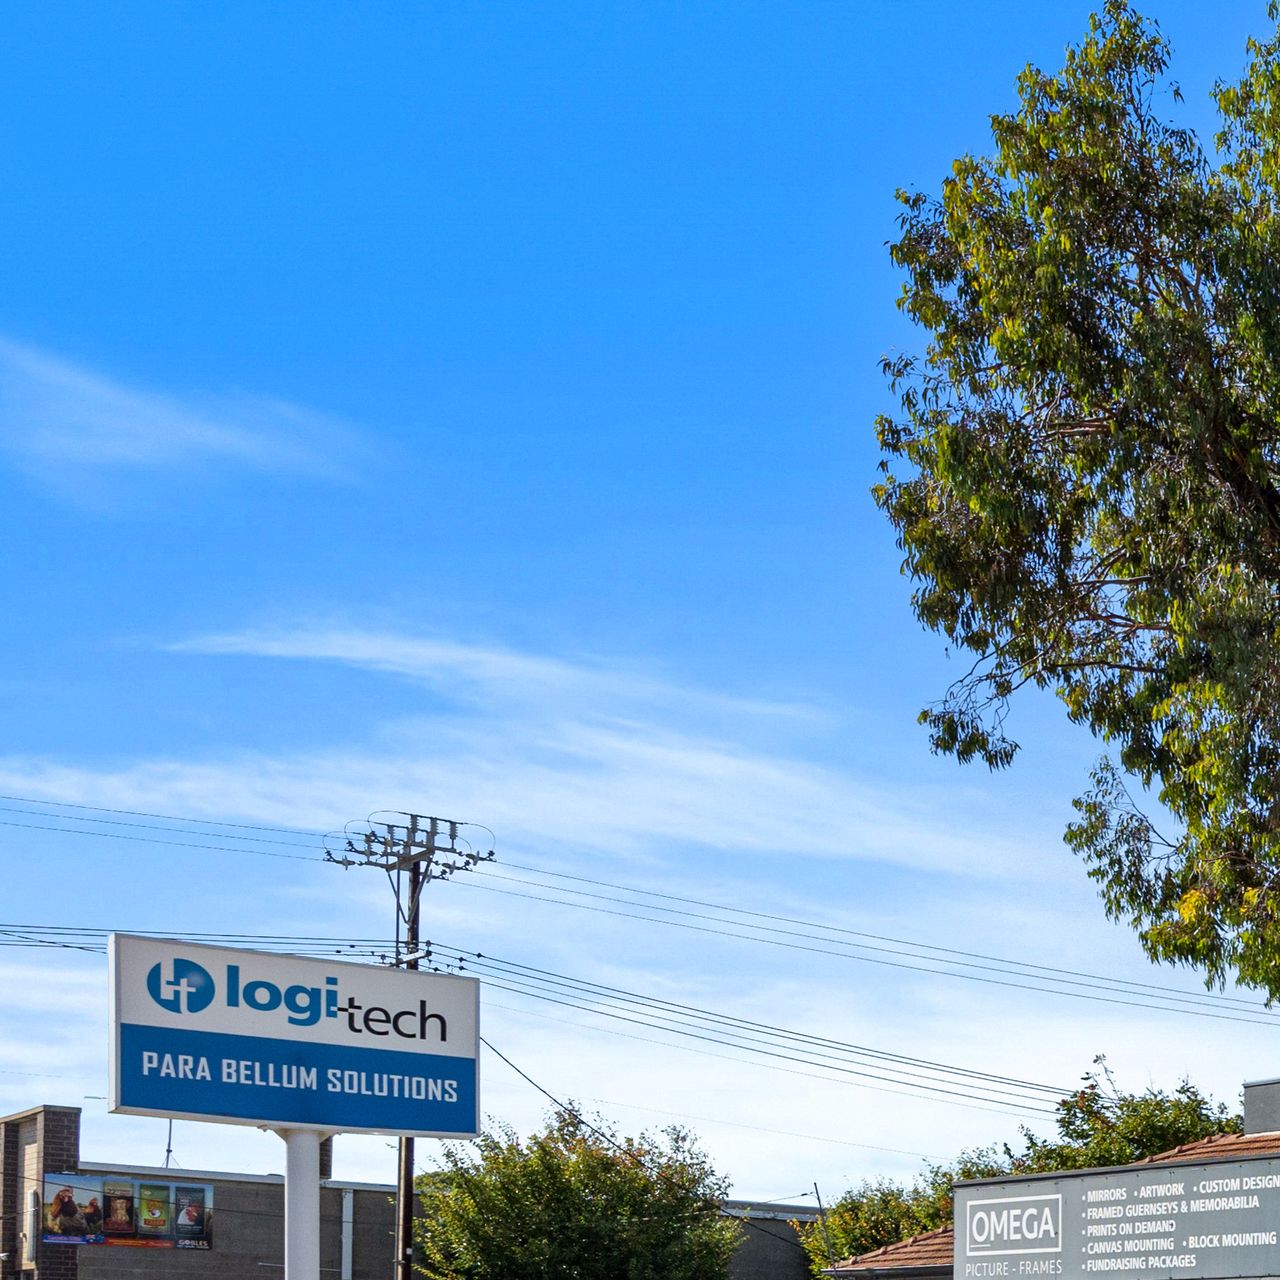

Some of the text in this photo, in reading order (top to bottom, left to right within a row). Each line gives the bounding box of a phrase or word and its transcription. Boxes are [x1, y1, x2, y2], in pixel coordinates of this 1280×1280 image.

[142, 1050, 458, 1103] PARA BELLUM SOLUTIONS
[1087, 1188, 1127, 1202] MIRRORS
[1139, 1182, 1185, 1198] ARTWORK
[1199, 1178, 1240, 1193] CUSTOM
[1087, 1195, 1260, 1219] FRAMED GUERNSEYS & MEMORABILIA
[972, 1207, 1055, 1242] OMEGA
[1087, 1219, 1176, 1237] PRINTS ON DEMAND
[1087, 1231, 1277, 1254] CANVAS MOUNTING BLOCK MOUNTING
[965, 1262, 1009, 1277] PICTURE
[1019, 1259, 1063, 1274] FRAMES
[1087, 1254, 1196, 1271] FUNDRAISING PACKAGES
